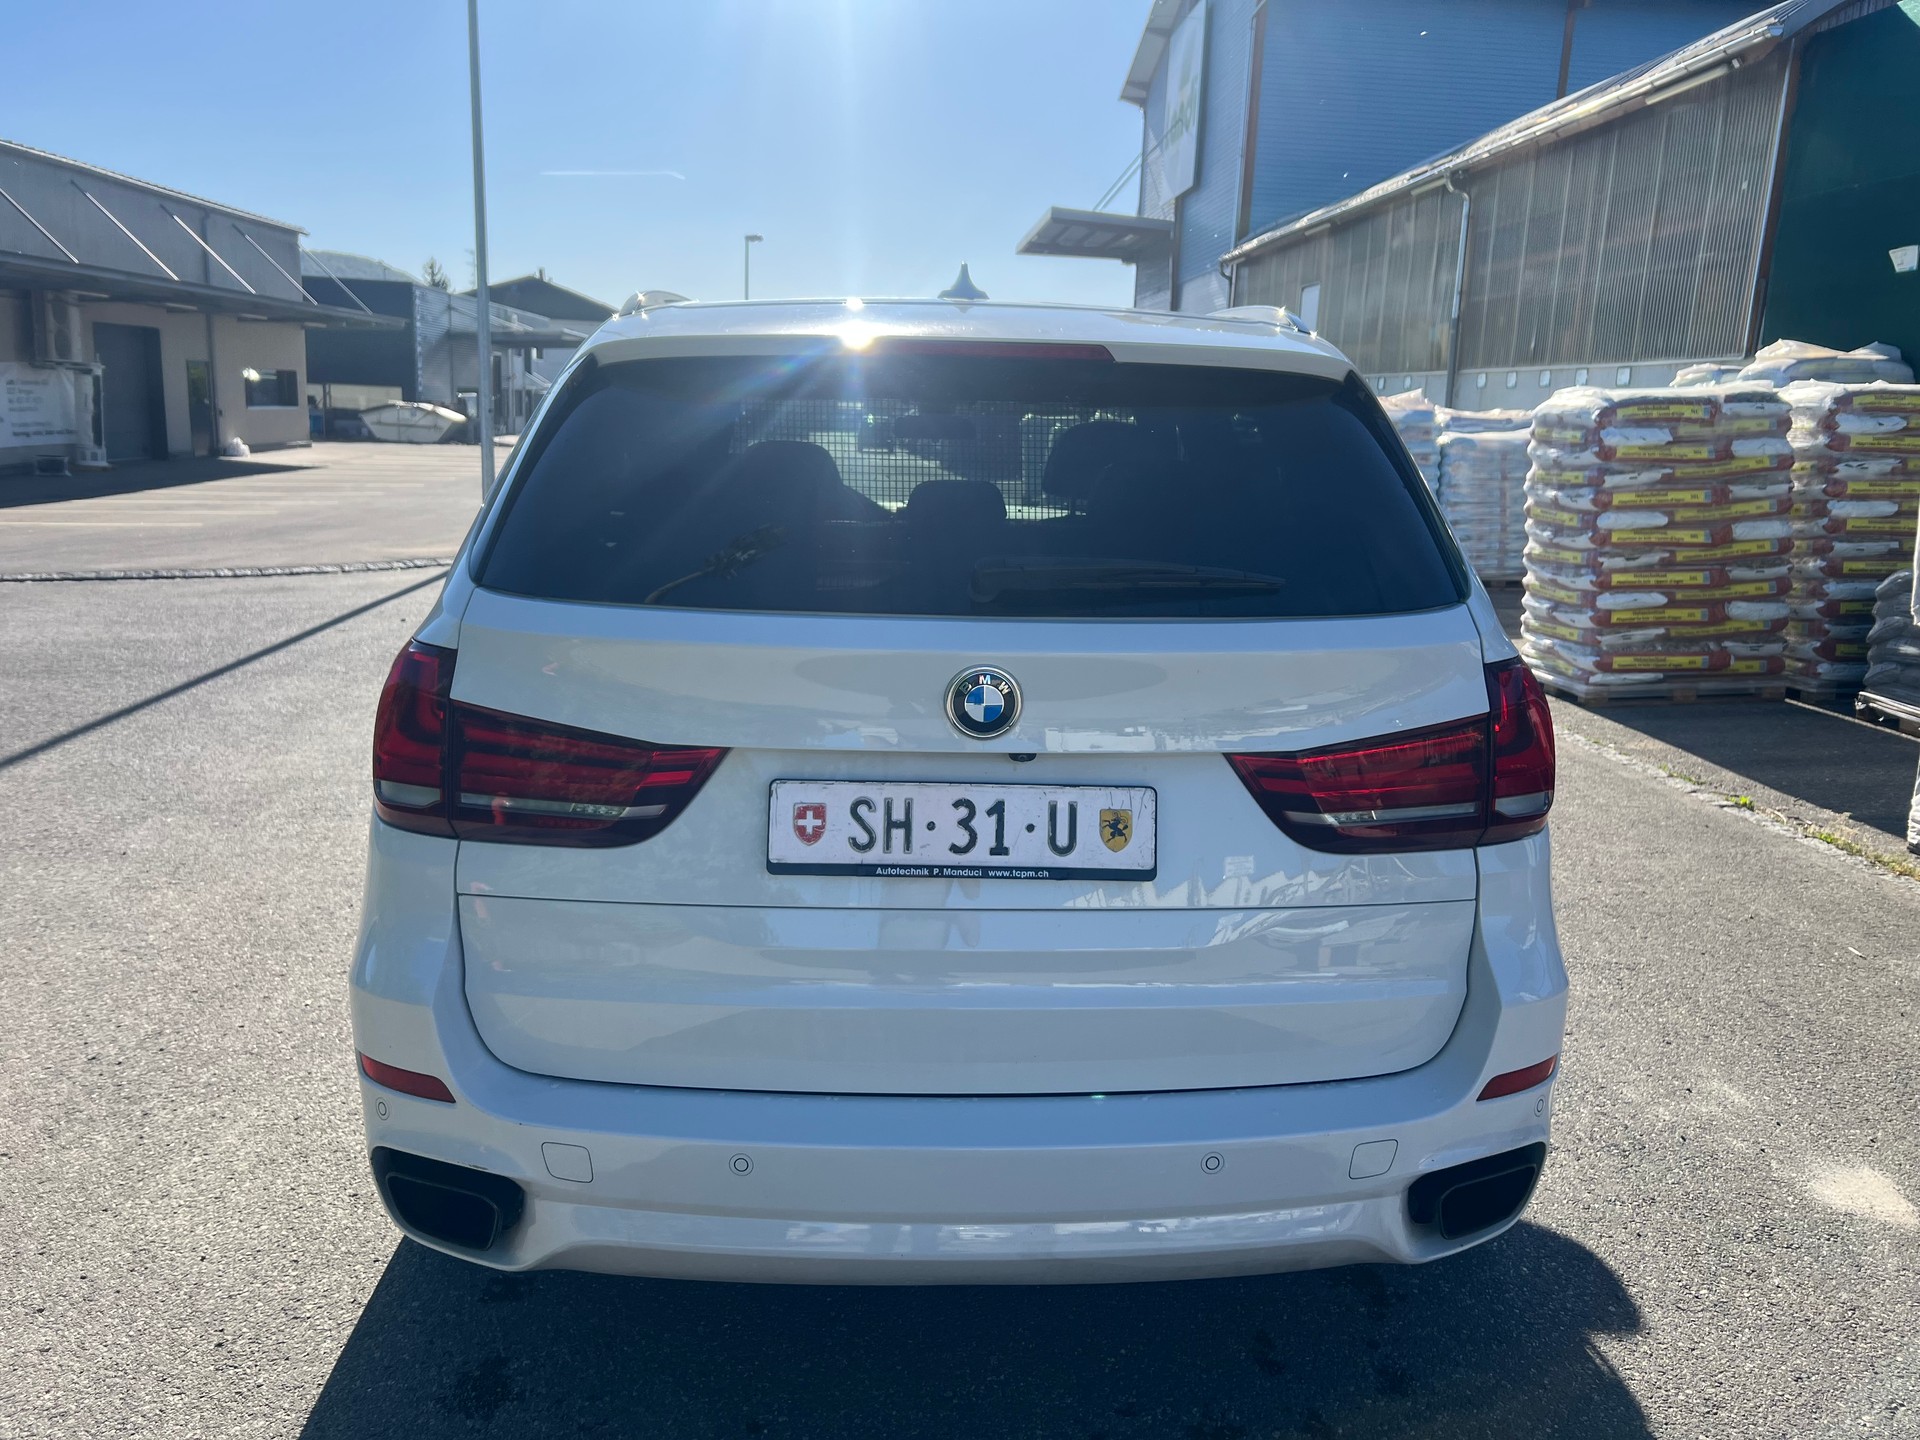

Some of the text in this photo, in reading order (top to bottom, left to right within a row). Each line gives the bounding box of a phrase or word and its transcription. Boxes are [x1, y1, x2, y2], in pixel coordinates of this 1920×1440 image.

[959, 674, 1012, 695] BMW
[875, 866, 1049, 878] Autotechnik P. Manduci www.tcpm.ch
